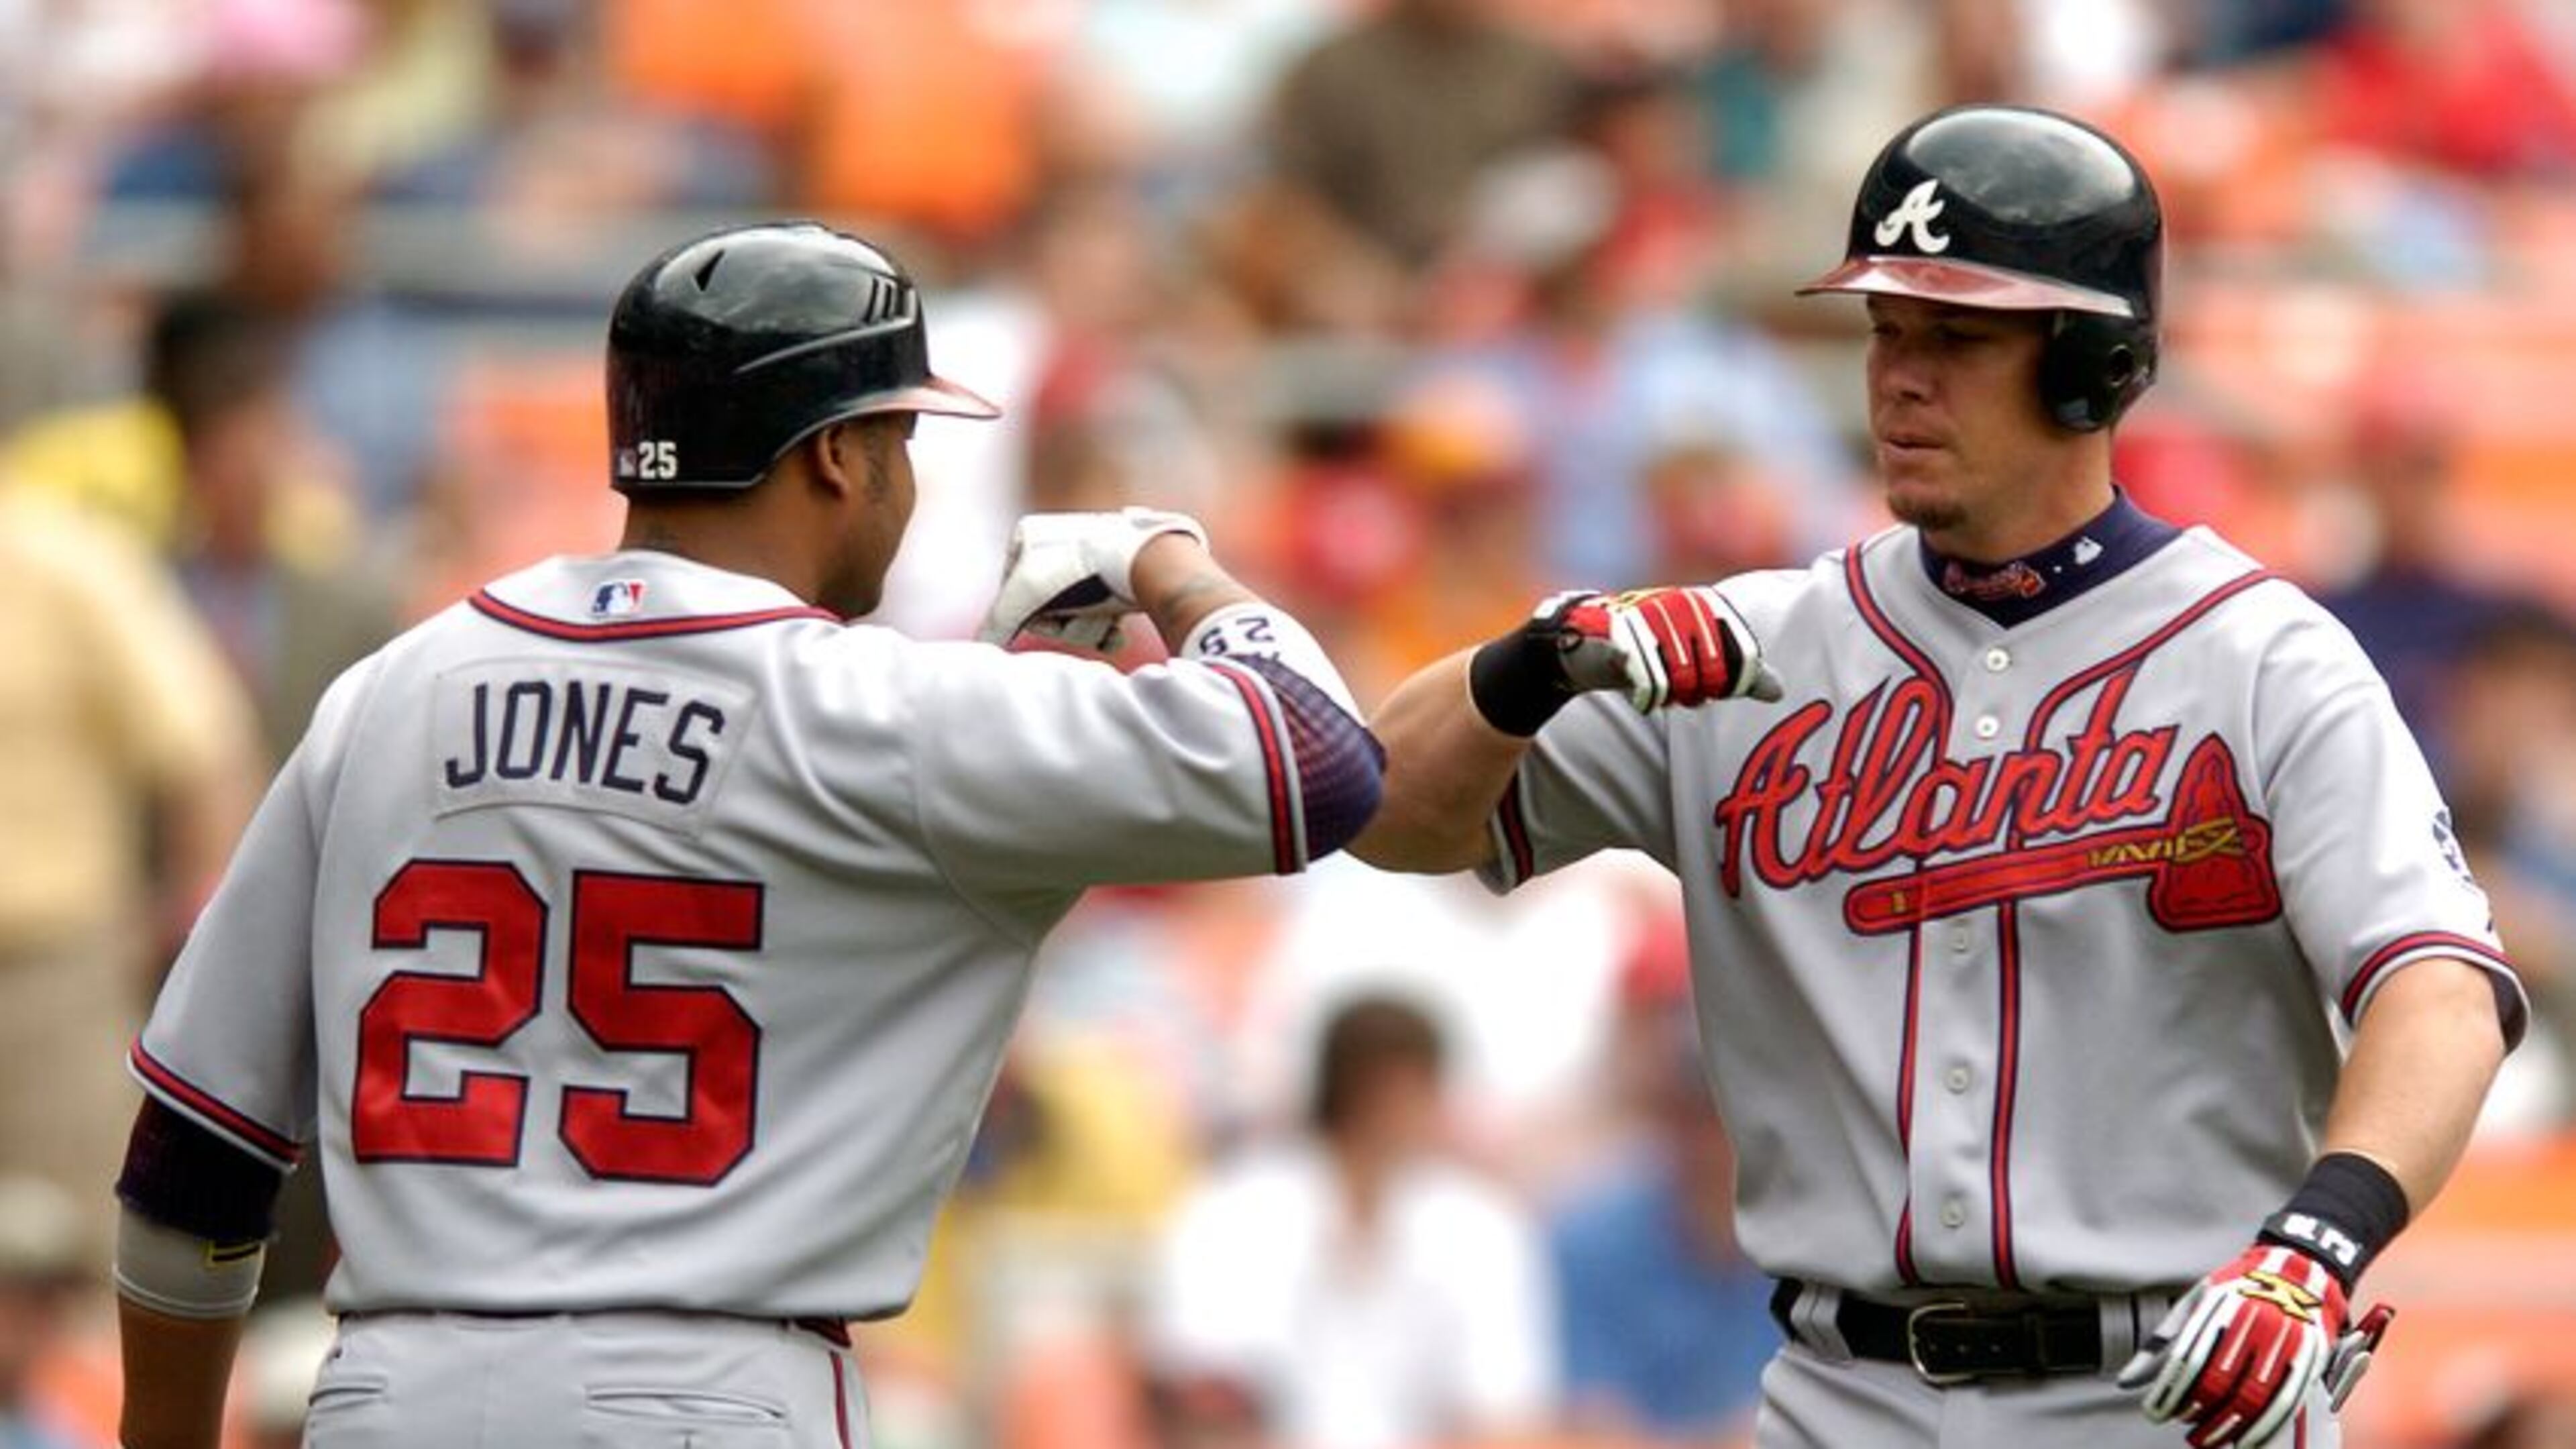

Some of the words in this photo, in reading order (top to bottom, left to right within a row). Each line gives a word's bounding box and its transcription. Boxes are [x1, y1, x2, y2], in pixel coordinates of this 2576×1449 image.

[1875, 178, 1951, 254] A
[639, 441, 678, 480] 25
[445, 679, 725, 805] JONES
[1715, 669, 2182, 898] Atlanta
[352, 858, 765, 1187] 25
